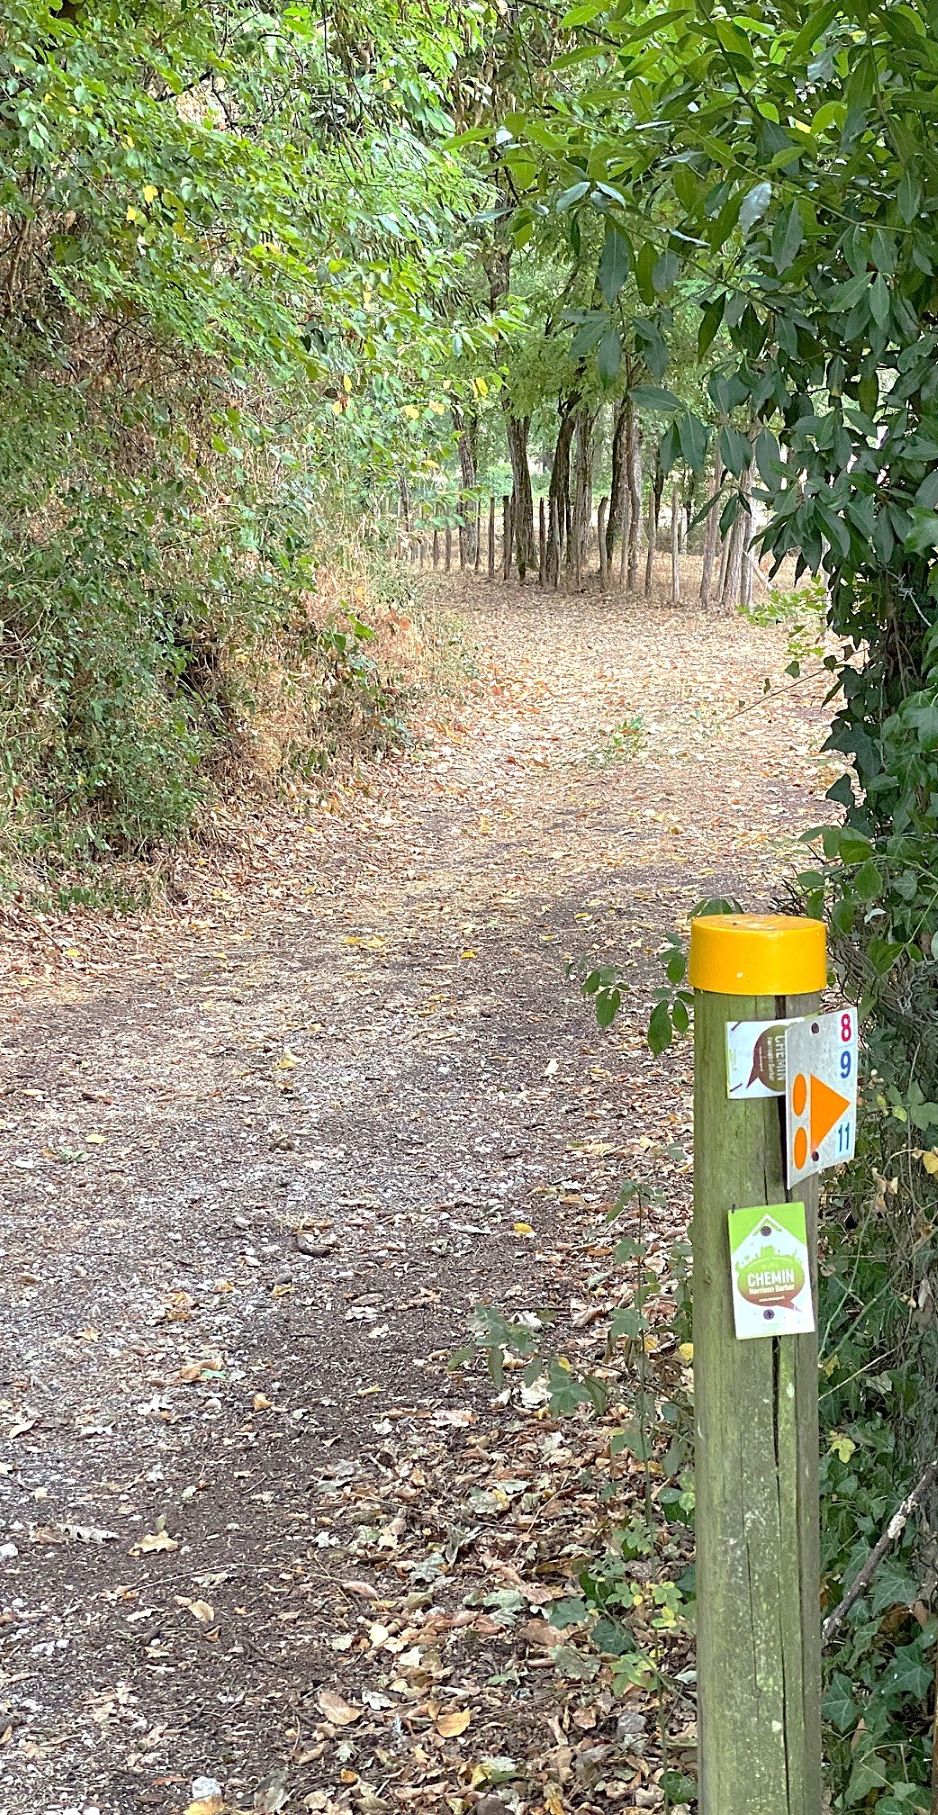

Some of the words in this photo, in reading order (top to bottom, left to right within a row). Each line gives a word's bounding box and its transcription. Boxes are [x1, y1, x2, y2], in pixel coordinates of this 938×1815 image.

[841, 1014, 851, 1042] 8
[774, 1035, 785, 1081] CHEMIN
[840, 1051, 851, 1079] 9
[838, 1122, 850, 1152] 11
[748, 1269, 795, 1287] CHEMIN
